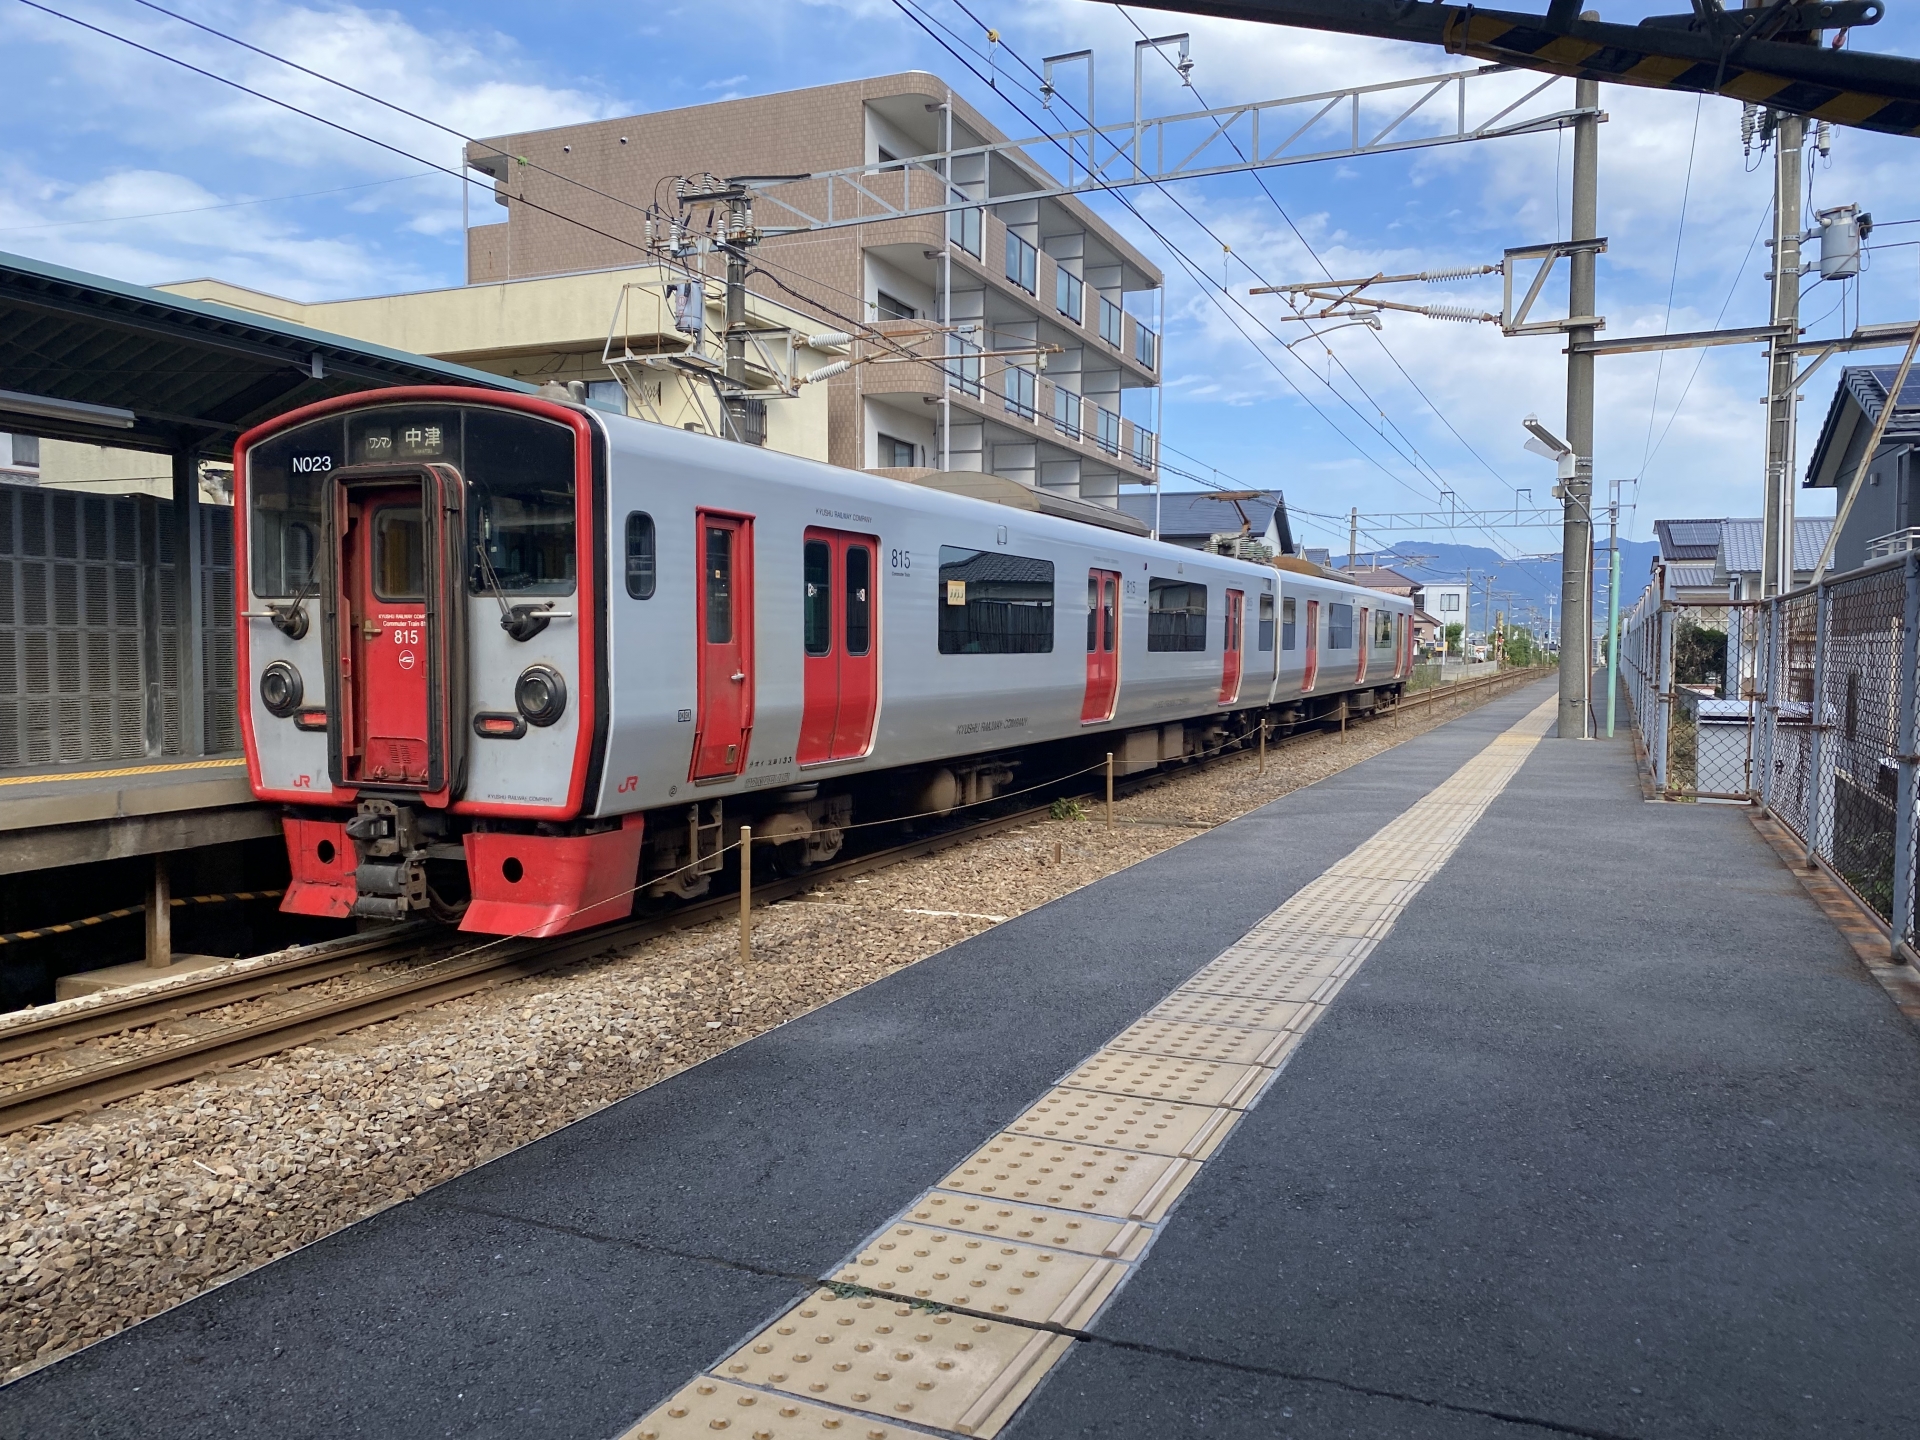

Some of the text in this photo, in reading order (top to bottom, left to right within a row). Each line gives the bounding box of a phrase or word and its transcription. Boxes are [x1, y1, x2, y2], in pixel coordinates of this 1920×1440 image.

[369, 437, 392, 449] ワンマン
[405, 426, 441, 448] 中津
[816, 508, 872, 523] KYUSHU RAILWAY COMPANY
[891, 548, 911, 569] 815
[394, 629, 419, 645] 815
[293, 775, 310, 788] JR
[618, 775, 639, 793] JR
[507, 794, 527, 802] RAILWAY
